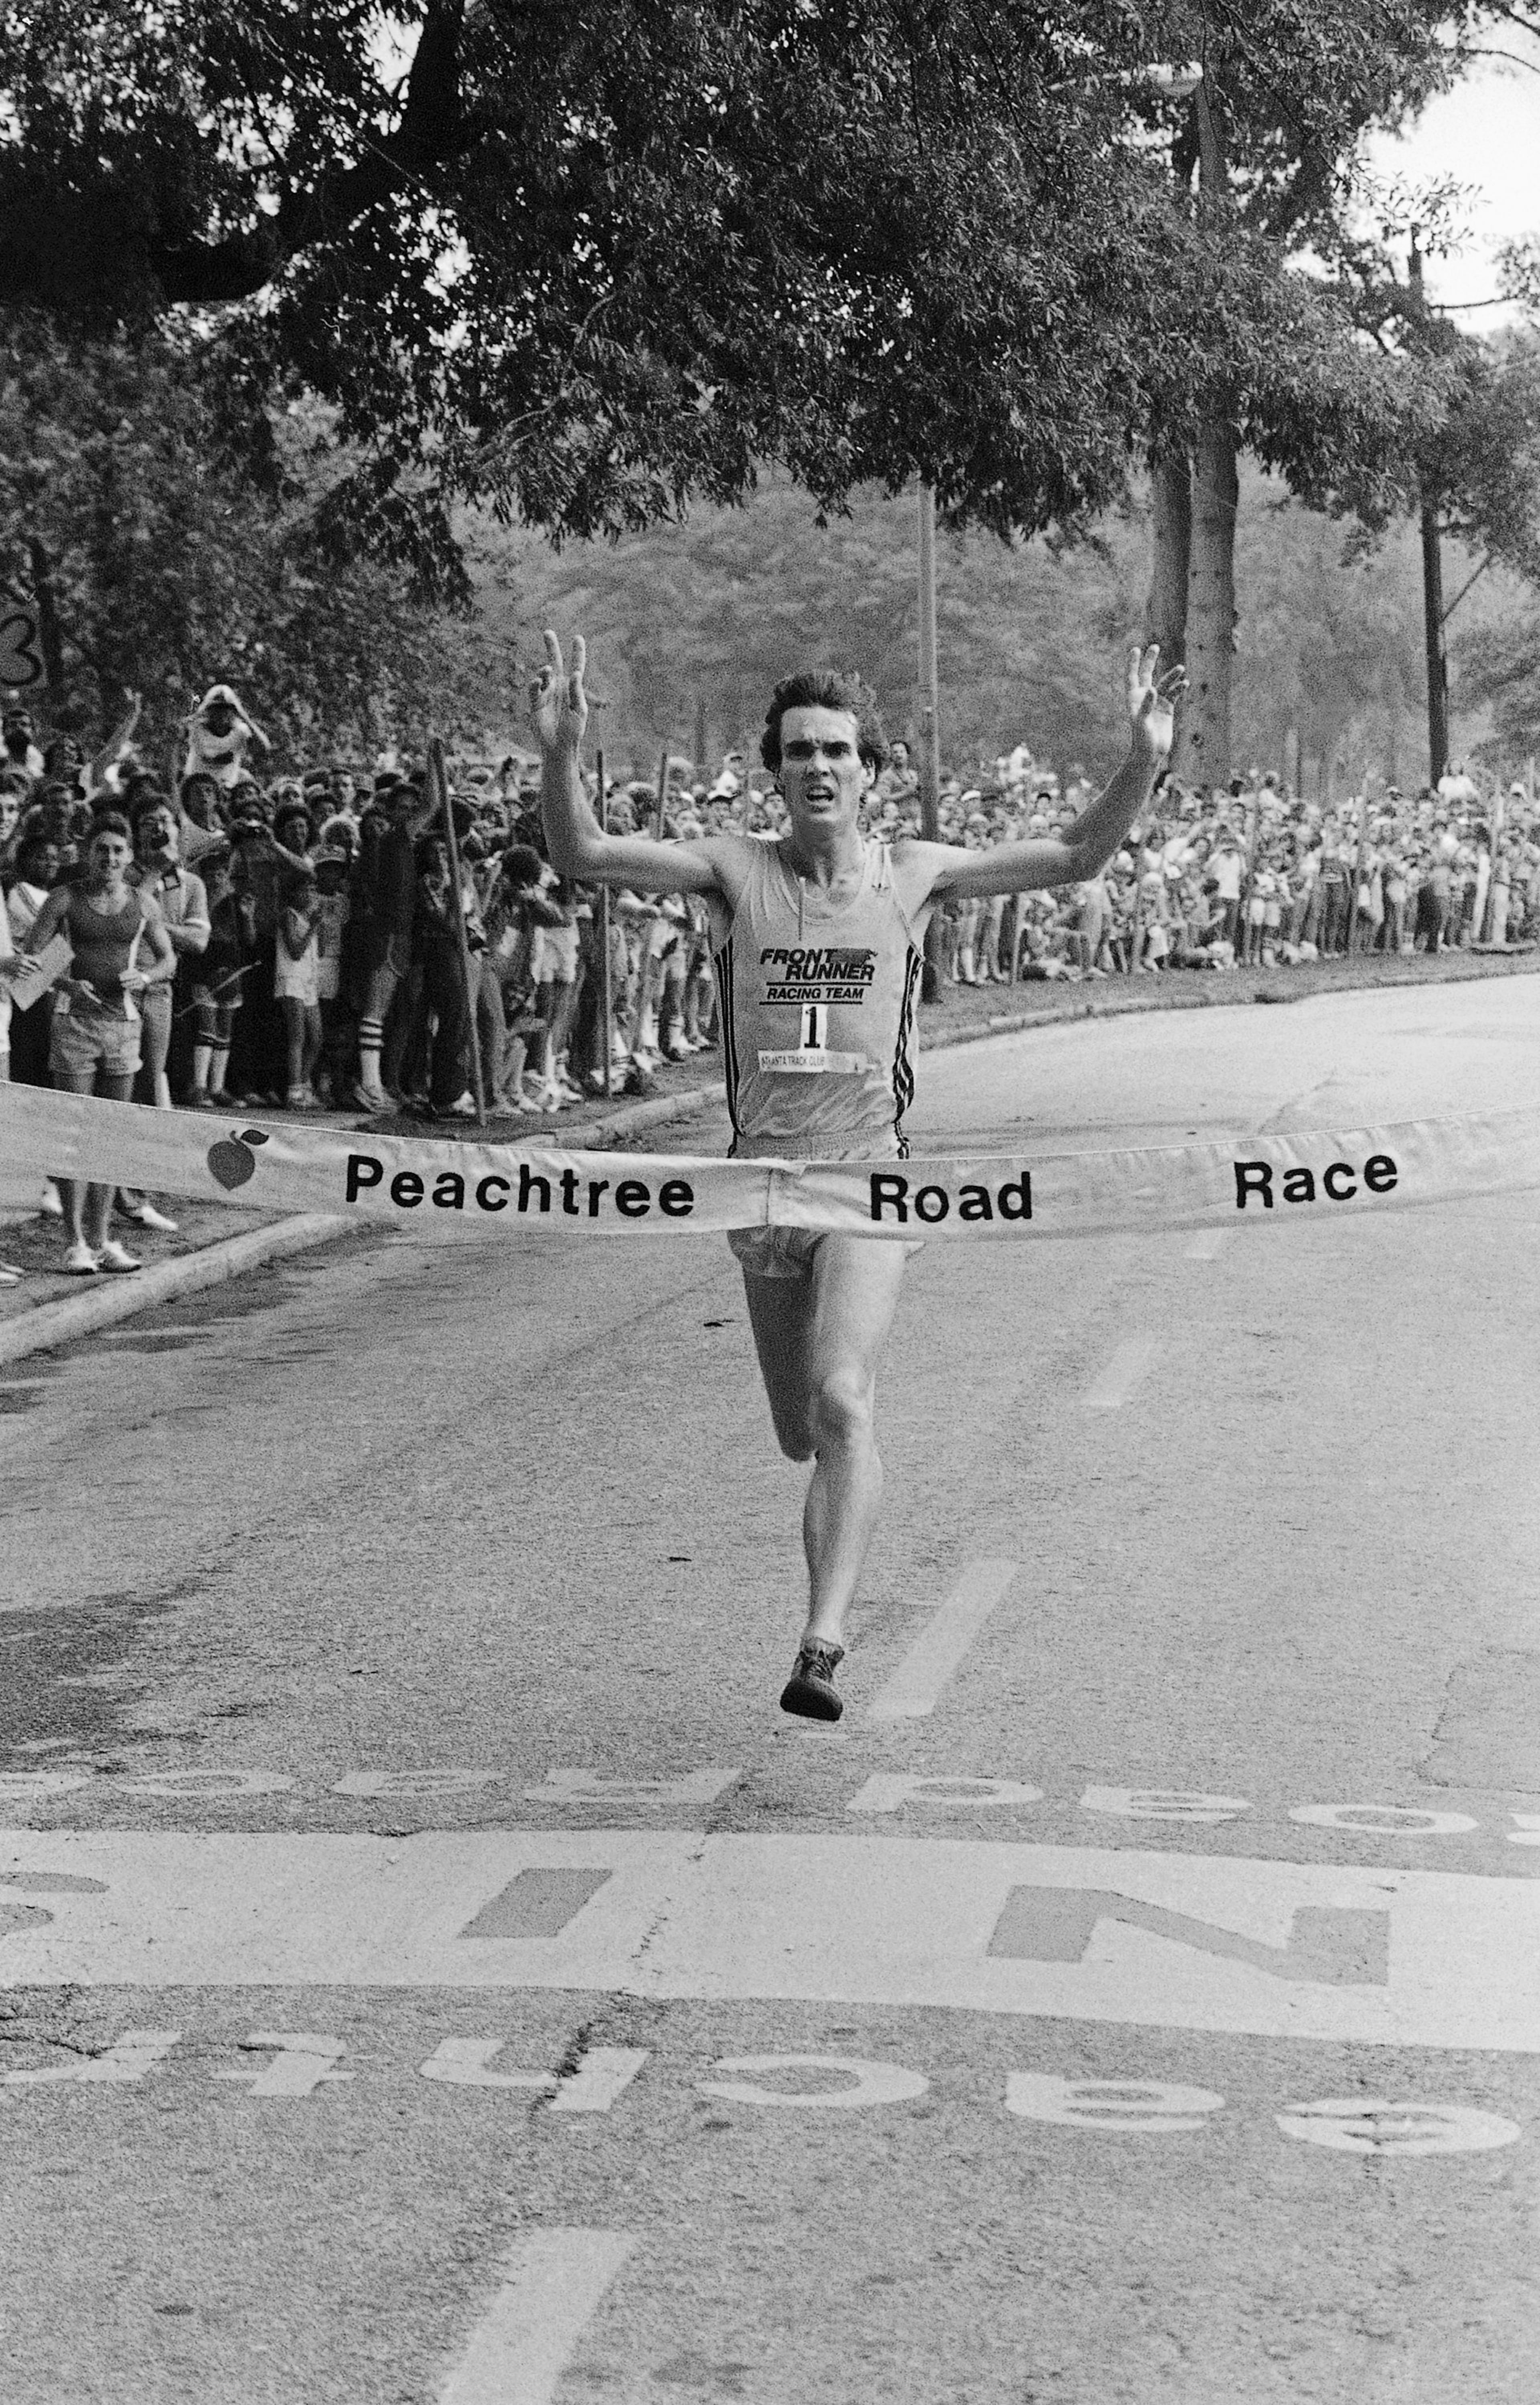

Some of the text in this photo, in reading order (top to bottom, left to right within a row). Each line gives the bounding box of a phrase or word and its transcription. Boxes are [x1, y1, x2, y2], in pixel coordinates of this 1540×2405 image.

[760, 948, 838, 965] FRONT
[785, 963, 875, 981] RUNNER
[767, 988, 864, 1000] RACING TEAM
[804, 1006, 820, 1048] 1
[345, 1154, 1398, 1223] Peachtree Road Race
[845, 1773, 1540, 1846] oad
